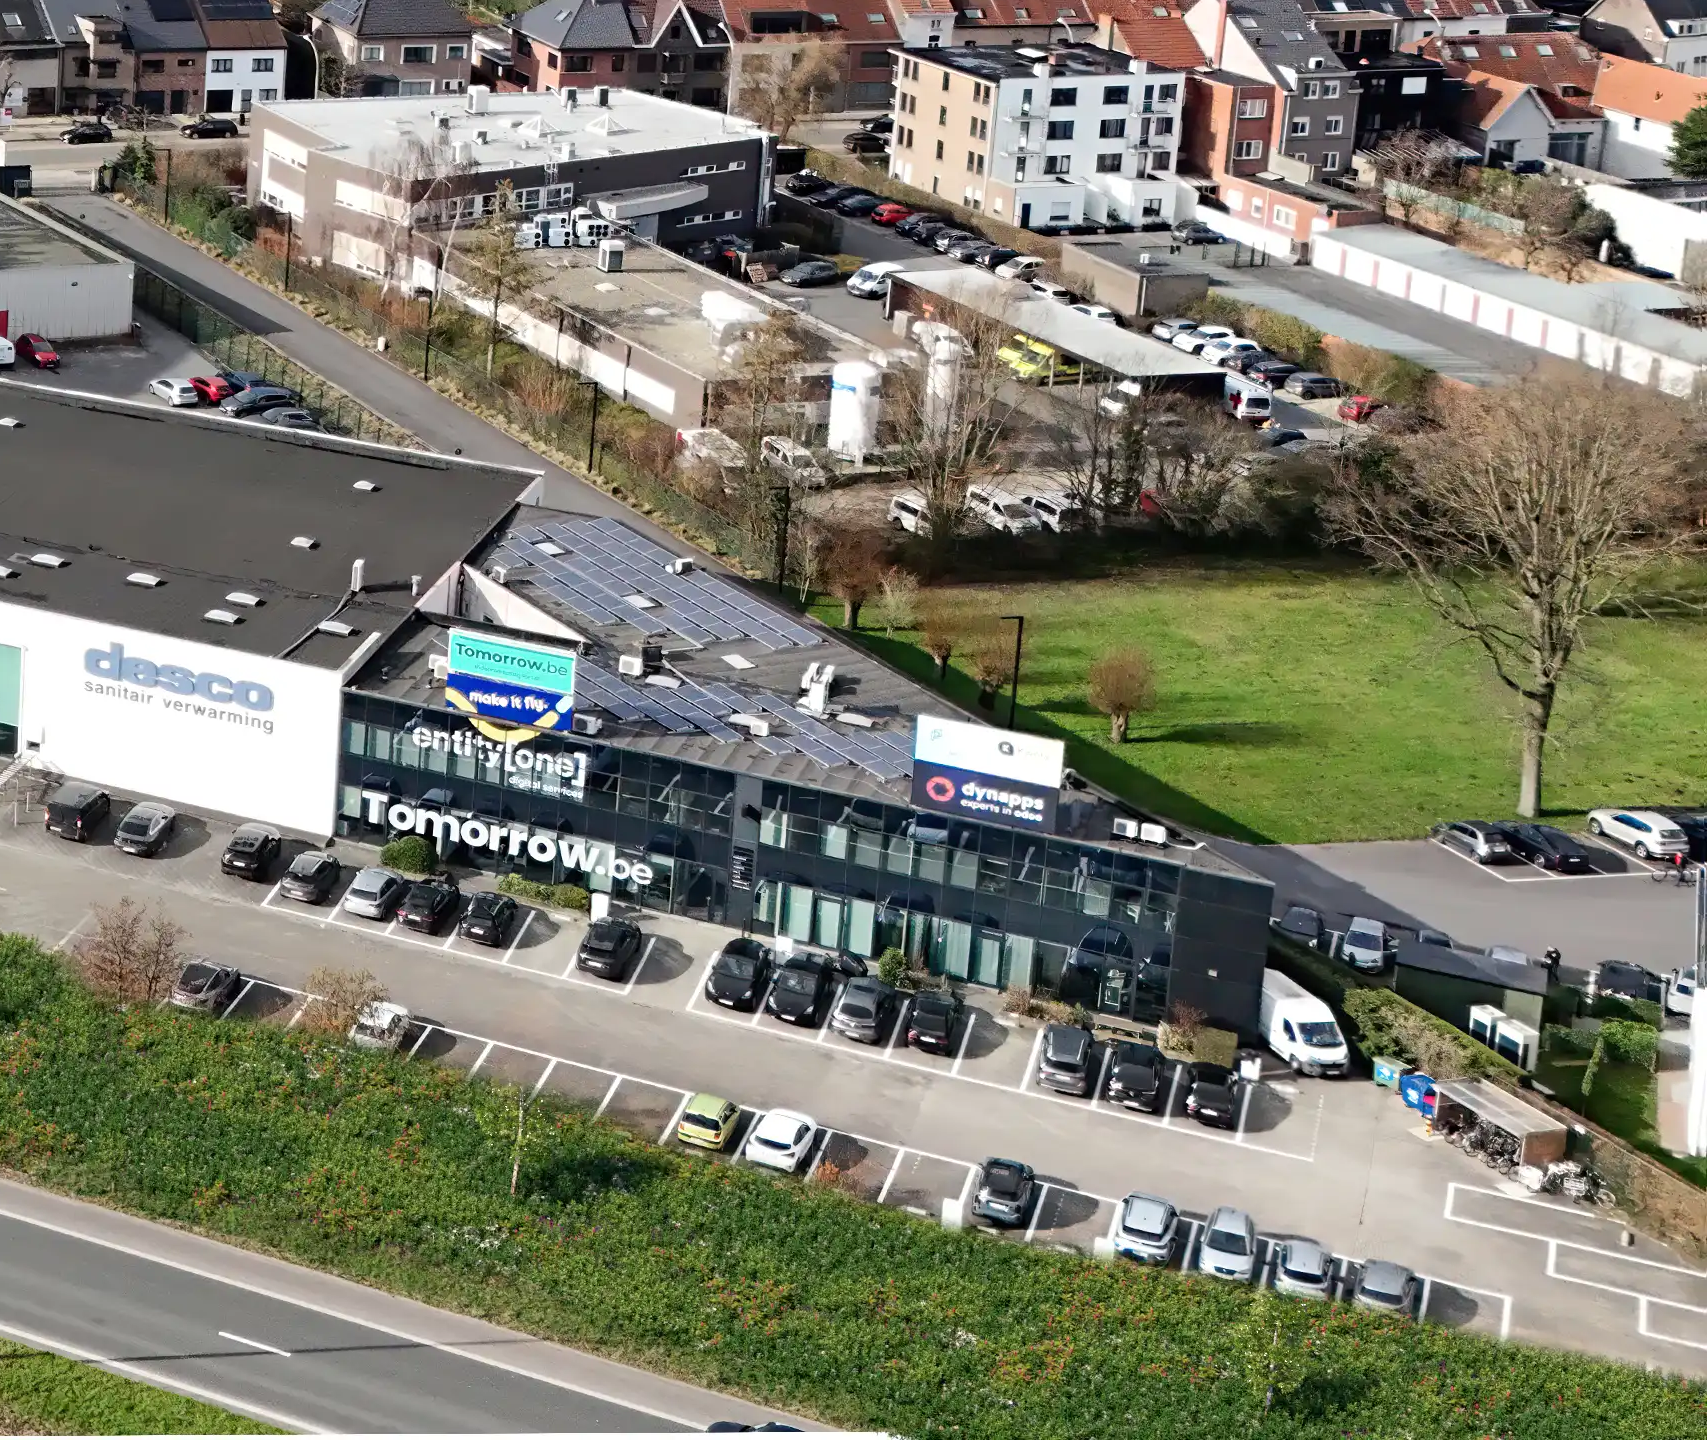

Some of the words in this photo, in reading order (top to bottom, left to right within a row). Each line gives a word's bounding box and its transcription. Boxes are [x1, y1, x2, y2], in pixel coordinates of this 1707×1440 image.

[84, 641, 275, 712] desco
[455, 642, 568, 677] Tomorrow.be
[84, 680, 154, 705] sanitair
[163, 697, 275, 735] verwarming
[469, 690, 509, 708] make
[511, 694, 523, 710] it
[412, 726, 587, 788] entity[one]
[508, 775, 540, 791] digital
[961, 781, 1045, 811] dynapps
[960, 798, 1000, 814] experts
[1002, 805, 1012, 815] in
[1014, 809, 1043, 823] odoo
[361, 790, 653, 886] Tomorrow.be
